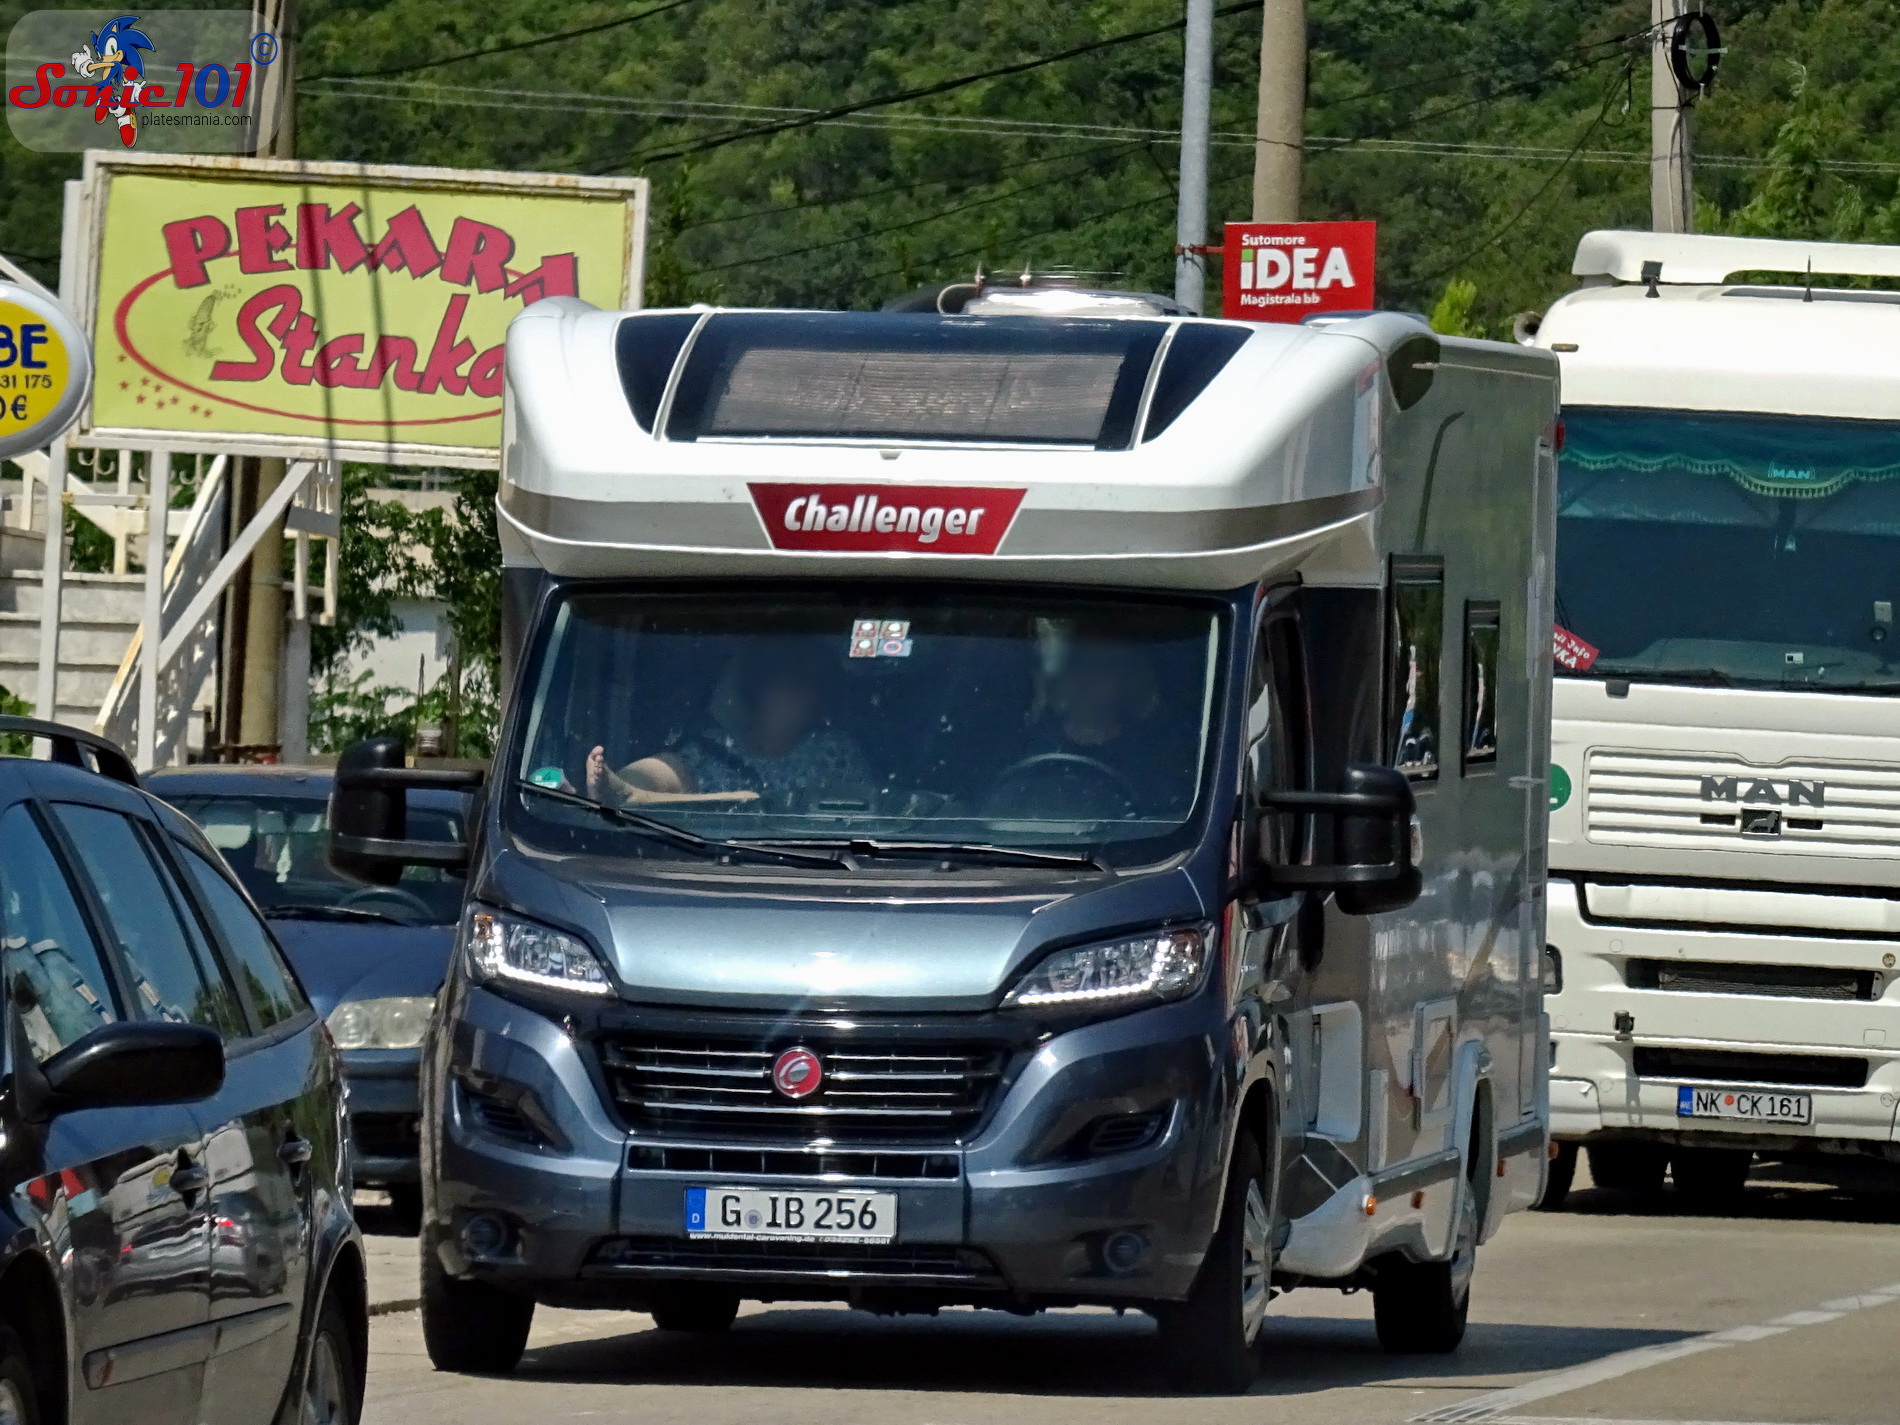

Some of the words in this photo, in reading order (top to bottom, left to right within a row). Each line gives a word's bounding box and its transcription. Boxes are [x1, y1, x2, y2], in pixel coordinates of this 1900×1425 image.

[1242, 234, 1305, 246] Sutomore
[163, 202, 580, 307] PEKARA
[1240, 293, 1301, 307] Magistrala
[1303, 293, 1321, 304] bb
[210, 284, 506, 398] Stanka
[25, 374, 52, 389] 175
[1772, 468, 1811, 480] MAN
[785, 494, 985, 543] Challenger
[1700, 775, 1825, 808] MAN
[1696, 1091, 1722, 1113] NK
[691, 1212, 701, 1224] D
[721, 1194, 741, 1227] G
[766, 1196, 805, 1229] IB
[813, 1197, 877, 1230] 256
